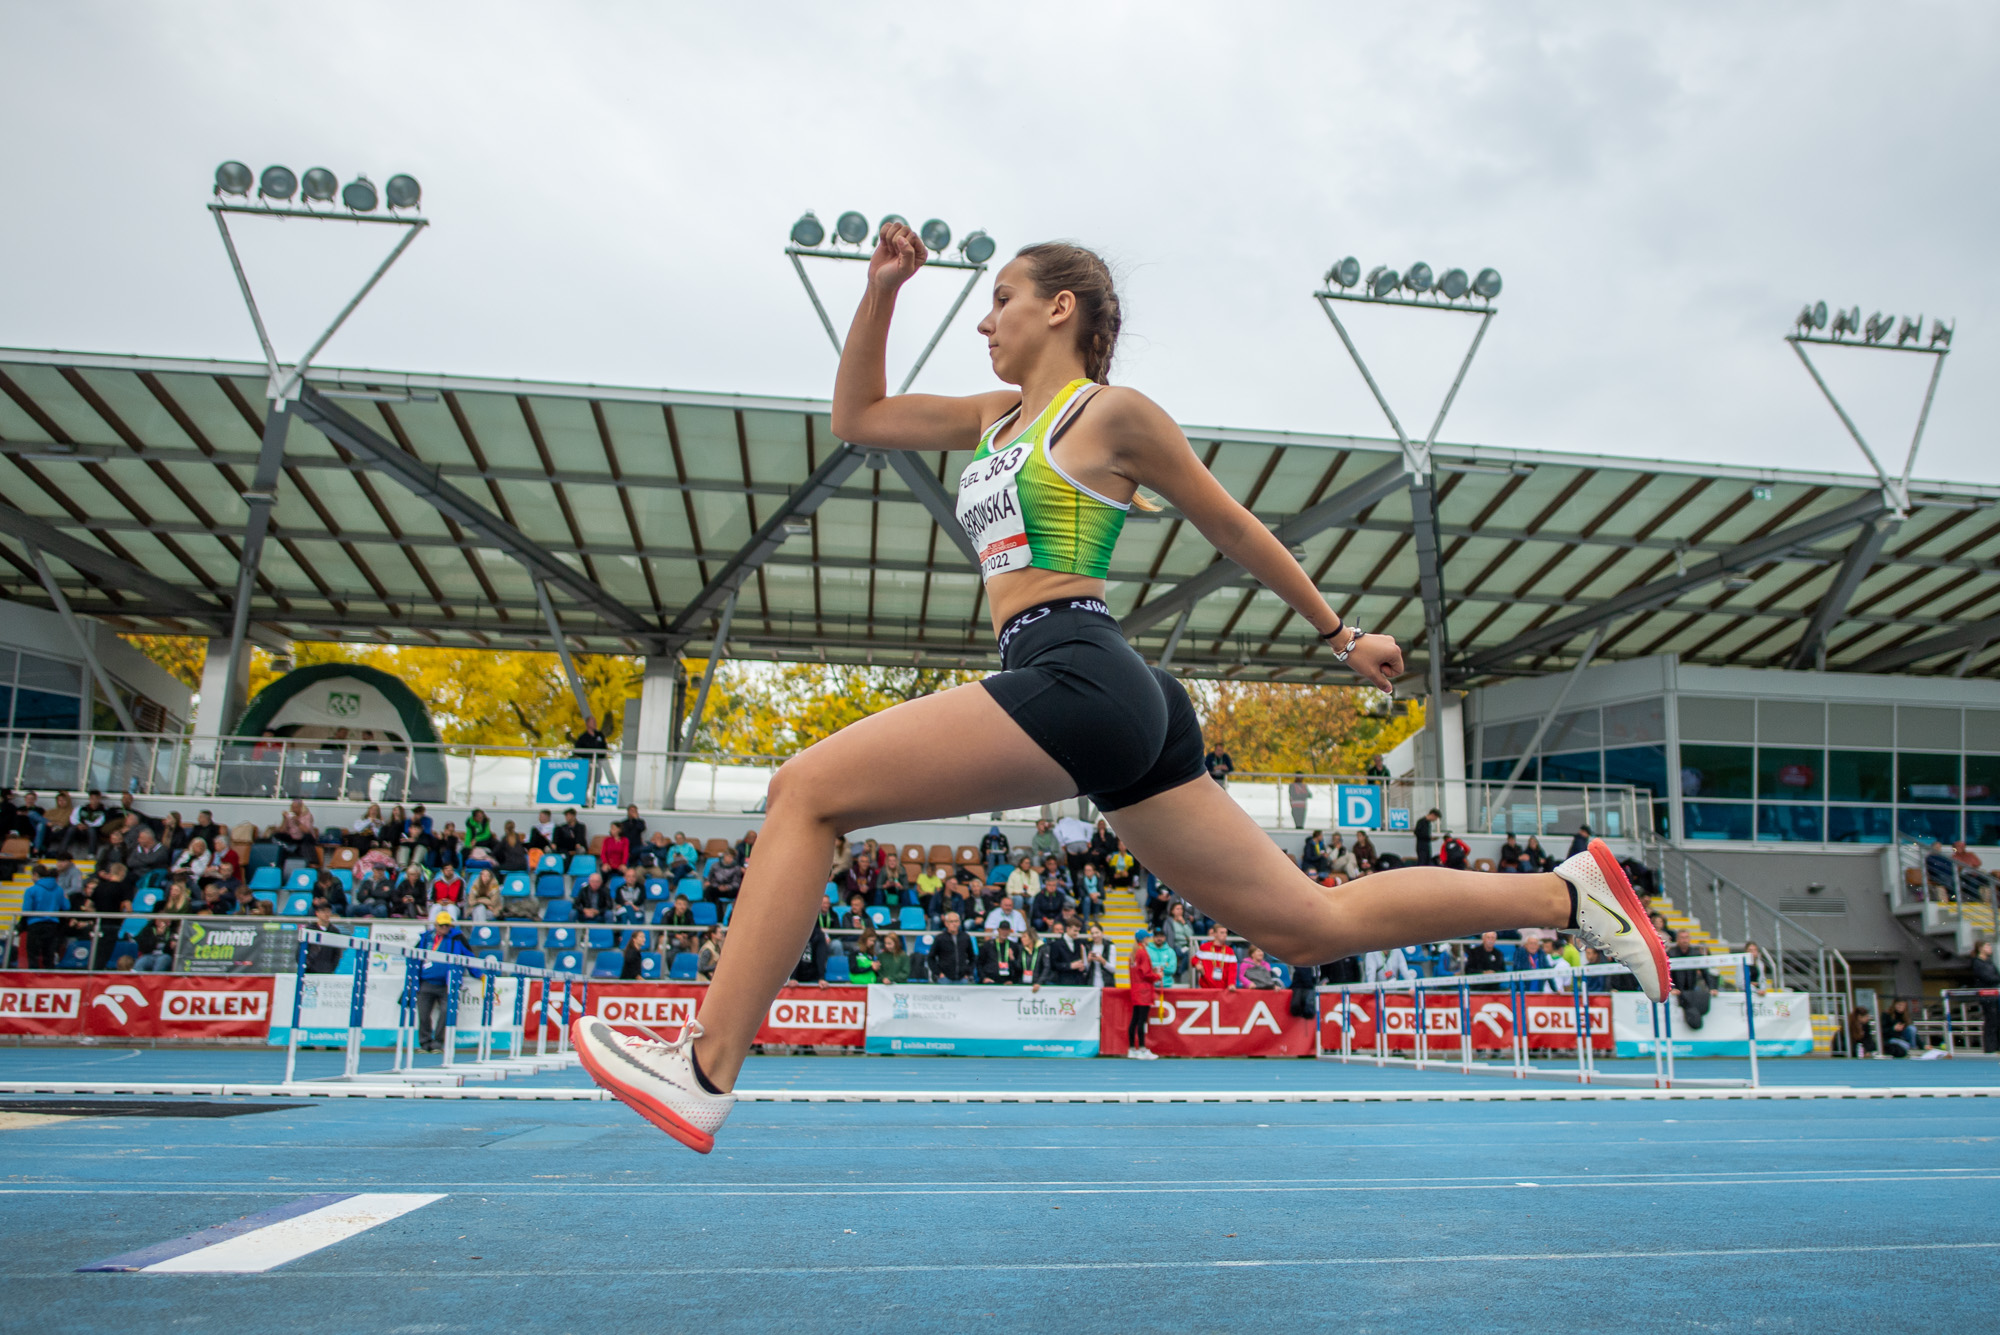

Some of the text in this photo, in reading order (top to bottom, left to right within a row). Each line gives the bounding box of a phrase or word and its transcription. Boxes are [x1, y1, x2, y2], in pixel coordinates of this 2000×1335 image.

[985, 447, 1022, 481] 363
[548, 770, 576, 802] C
[598, 786, 618, 798] WC
[1347, 796, 1372, 824] D
[1391, 811, 1408, 820] WC
[206, 930, 257, 946] runner
[168, 996, 260, 1016] ORLEN
[604, 1002, 688, 1021] ORLEN
[776, 1004, 858, 1024] ORLEN
[1145, 1000, 1282, 1034] PZLA
